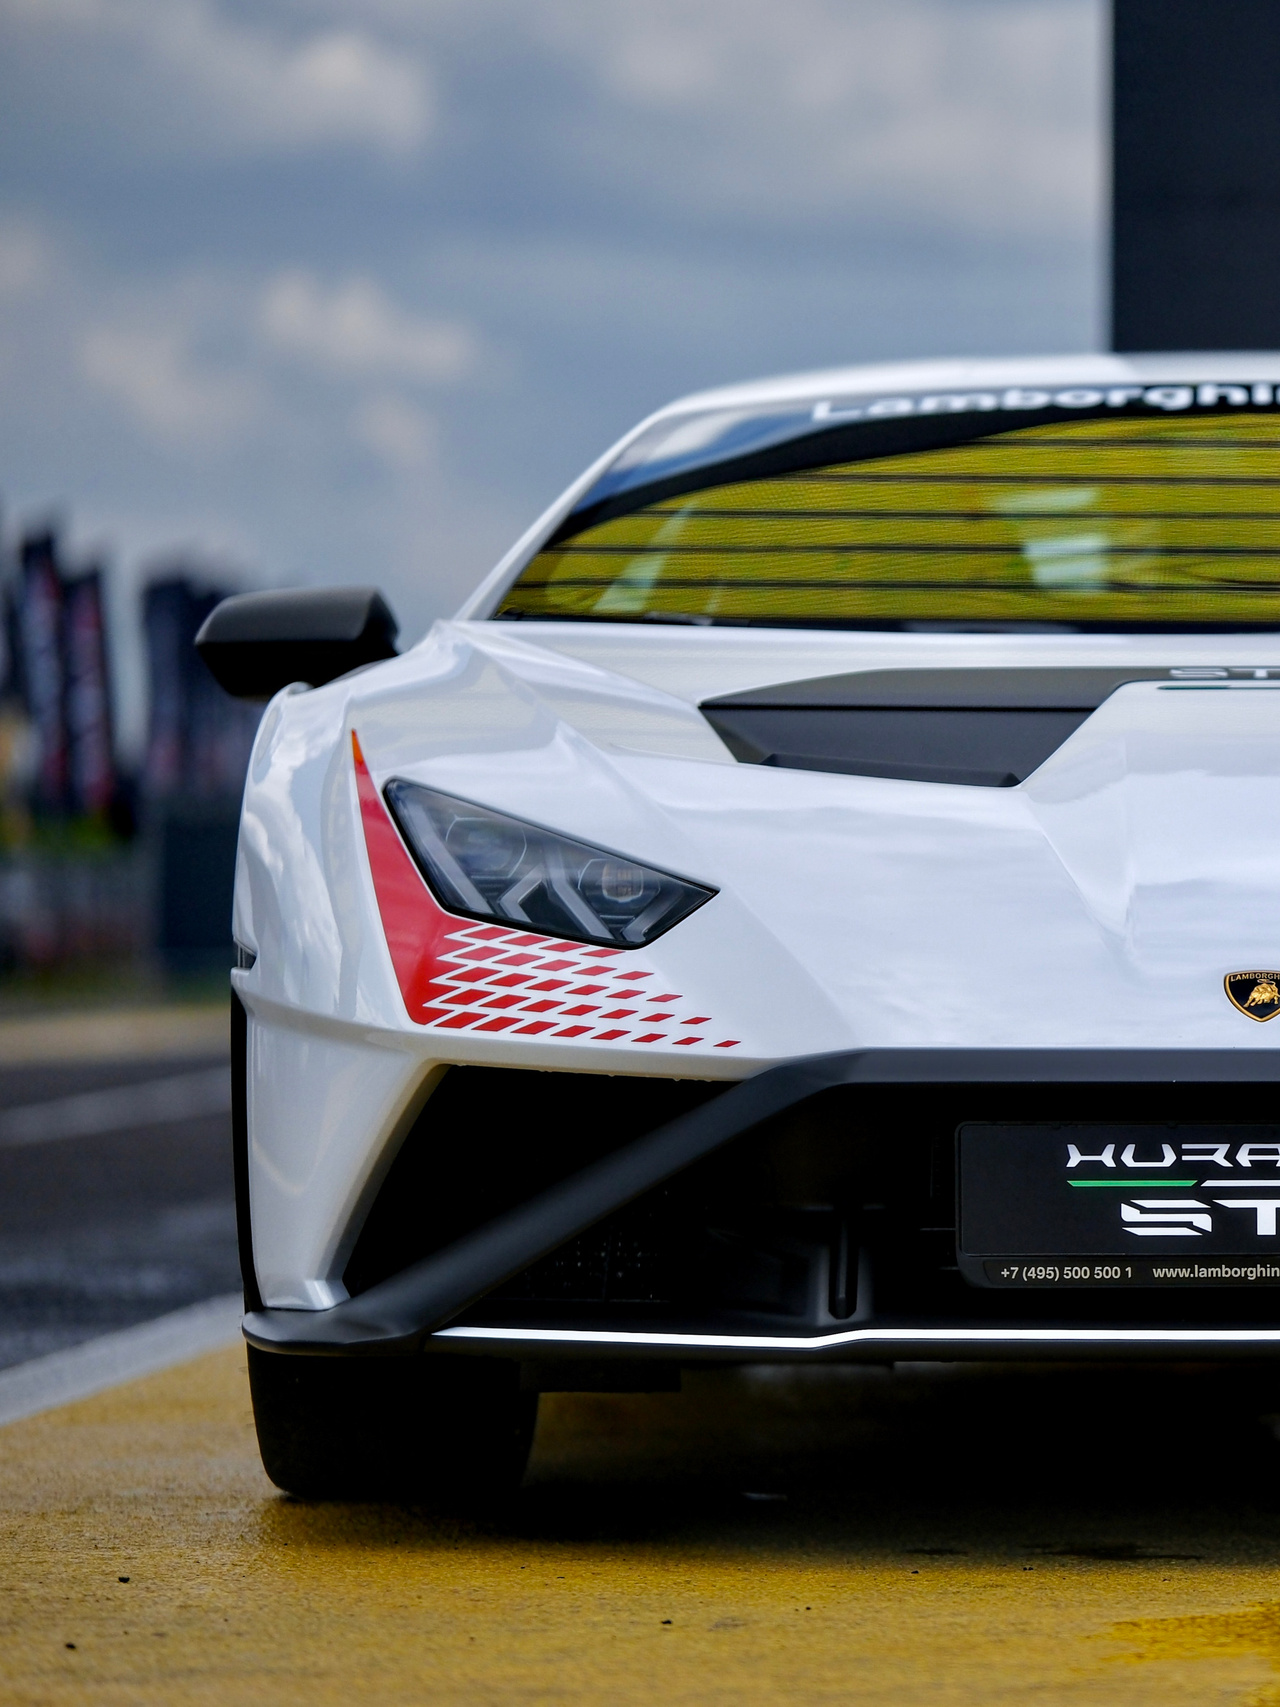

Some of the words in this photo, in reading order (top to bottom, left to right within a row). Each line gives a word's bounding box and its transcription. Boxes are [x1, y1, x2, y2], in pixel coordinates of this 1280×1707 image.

[1001, 1267, 1018, 1279] +7
[1022, 1266, 1060, 1281] (495)
[1063, 1266, 1090, 1279] 500
[1094, 1266, 1121, 1279] 500
[1125, 1266, 1132, 1278] 1
